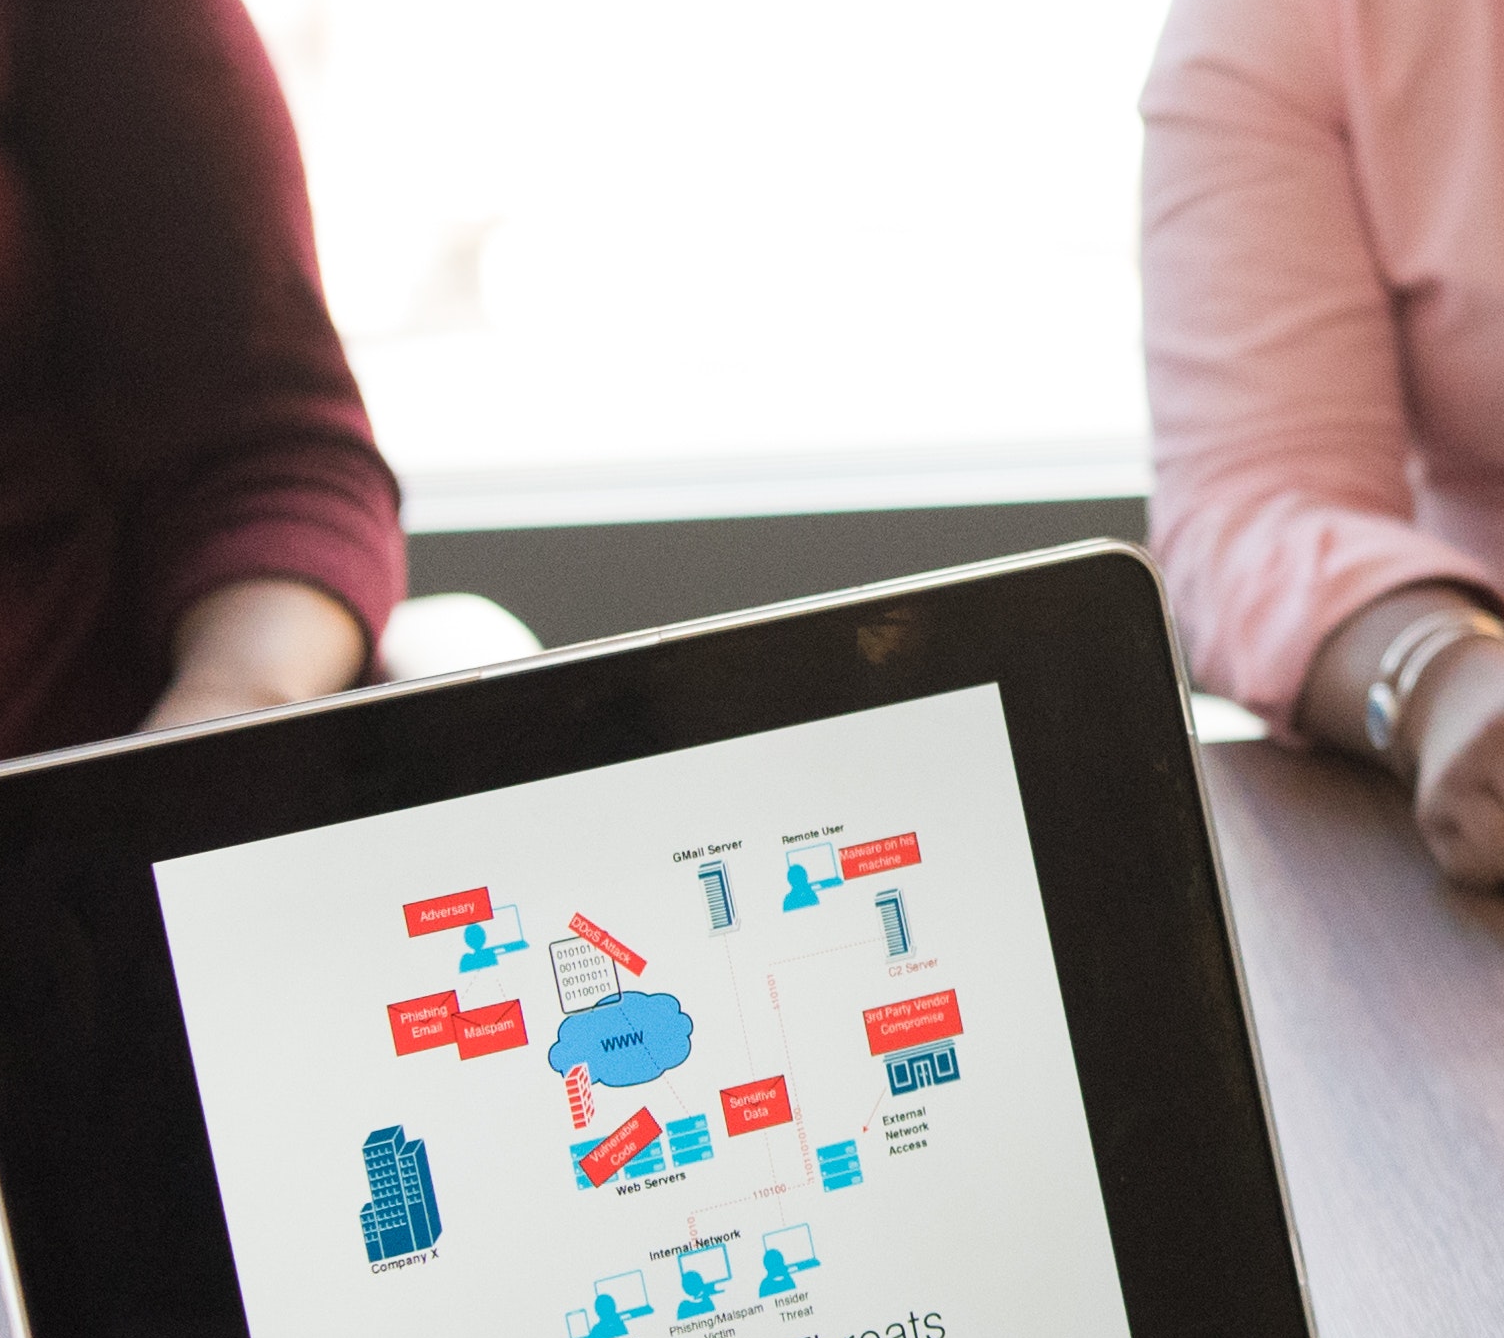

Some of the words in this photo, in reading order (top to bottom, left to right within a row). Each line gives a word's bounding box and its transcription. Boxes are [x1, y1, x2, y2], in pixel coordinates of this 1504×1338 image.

[782, 830, 820, 845] Remote
[822, 824, 844, 837] User
[672, 845, 705, 863] GMail
[708, 839, 742, 855] Server
[838, 842, 882, 860] Malware
[885, 839, 898, 850] on
[900, 835, 916, 847] his
[858, 854, 901, 872] machine
[420, 901, 476, 923] Adversary
[570, 916, 602, 942] DDoS
[600, 935, 631, 965] Attack
[559, 955, 606, 973] 00110101
[888, 965, 904, 978] C2
[906, 958, 938, 974] Server
[562, 969, 609, 987] 00101011
[564, 982, 612, 1001] 01100101
[400, 1004, 448, 1025] Phishing
[865, 1010, 883, 1025] 3rd
[885, 1003, 912, 1021] Party
[913, 994, 949, 1011] Vendor
[411, 1022, 443, 1039] Email
[464, 1017, 514, 1041] Malspam
[880, 1012, 944, 1036] Compromise
[730, 1089, 776, 1109] Sensitive
[743, 1105, 768, 1121] Data
[882, 1107, 926, 1126] External
[589, 1119, 640, 1163] Vulnerable
[885, 1122, 929, 1141] Network
[610, 1141, 636, 1167] Code
[888, 1139, 928, 1156] Access
[616, 1177, 641, 1197] Web
[644, 1171, 686, 1189] Servers
[649, 1241, 693, 1261] Internal
[695, 1229, 741, 1248] Network
[371, 1252, 426, 1275] Company
[430, 1247, 440, 1259] X
[774, 1291, 809, 1309] Insider
[669, 1303, 764, 1337] Phishing/Malspam
[780, 1305, 814, 1323] Threat
